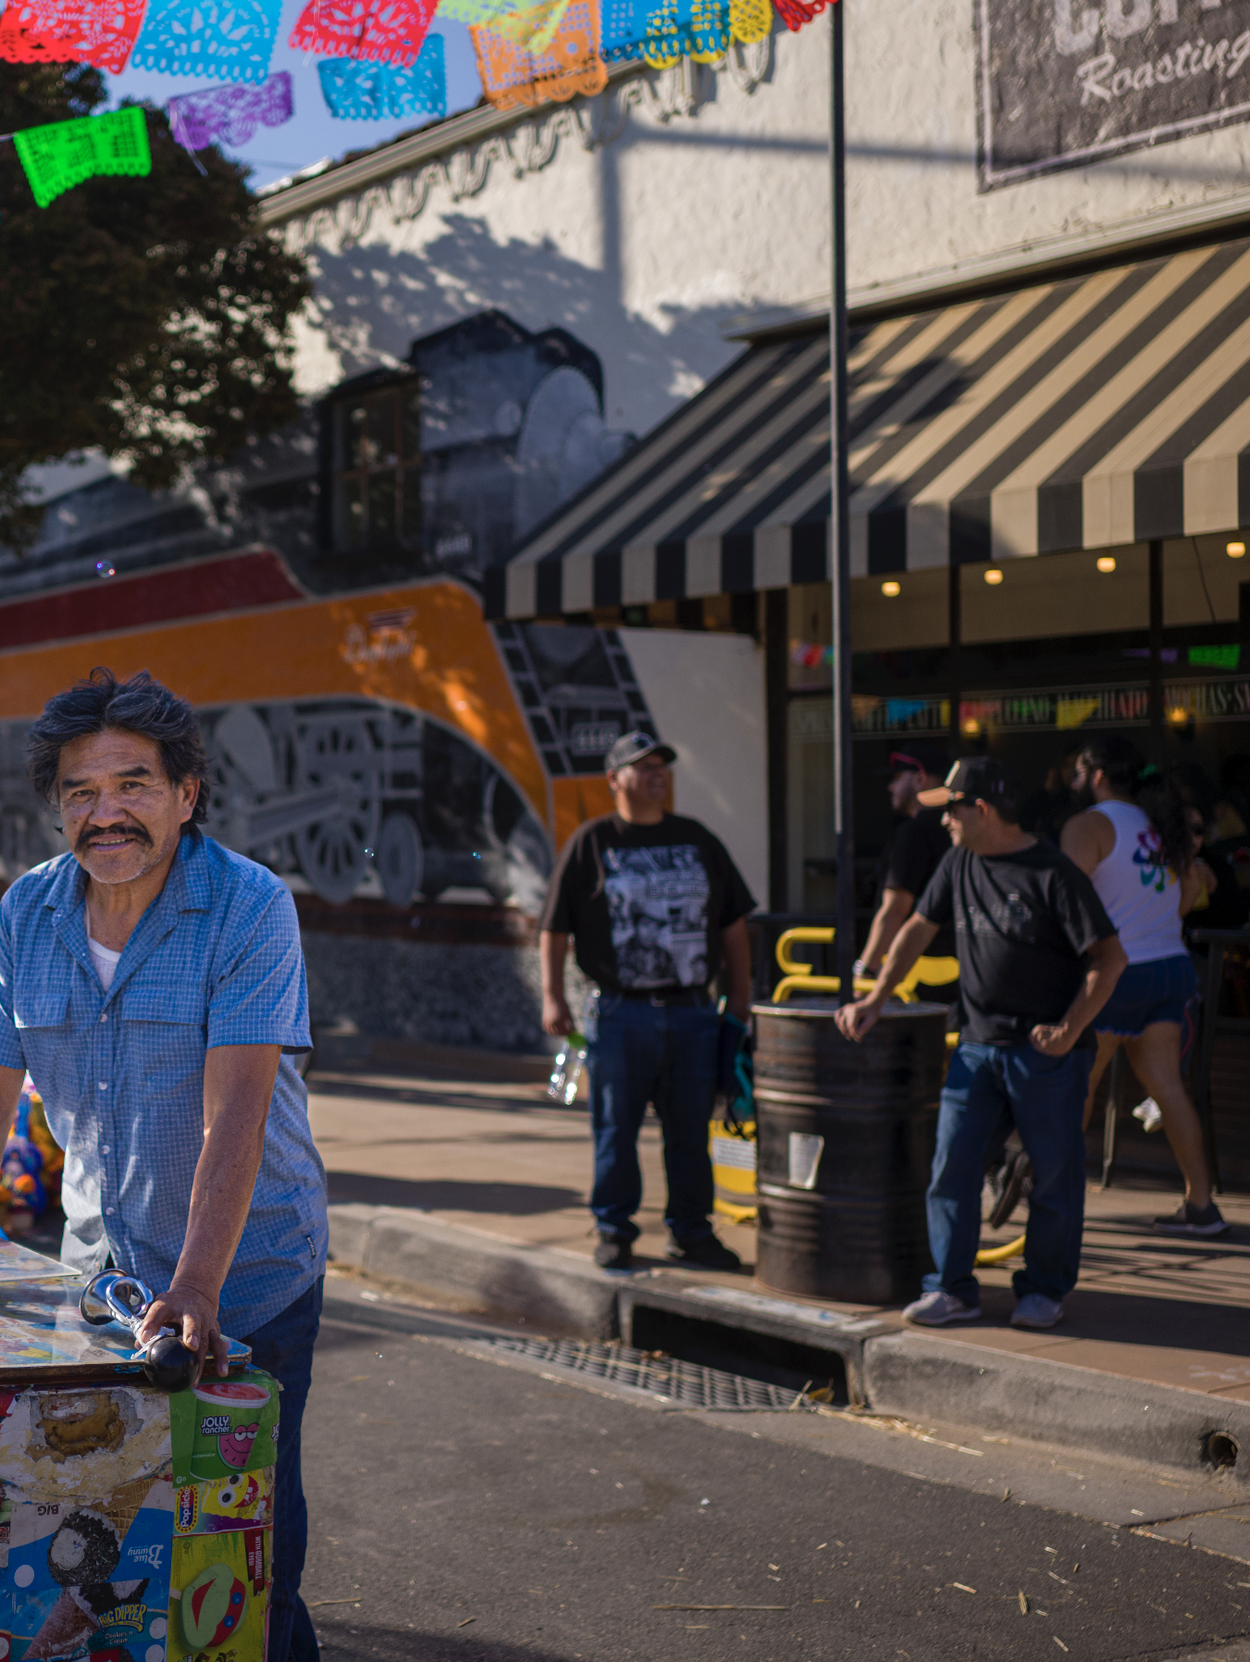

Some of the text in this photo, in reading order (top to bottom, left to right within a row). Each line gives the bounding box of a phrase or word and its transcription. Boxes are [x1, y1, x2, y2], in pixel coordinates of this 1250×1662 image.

[1076, 30, 1250, 108] Roasting
[202, 1416, 230, 1428] JOLLY
[202, 1426, 230, 1435] rancher
[37, 1504, 59, 1516] BIG
[254, 1550, 263, 1580] GUMBALL
